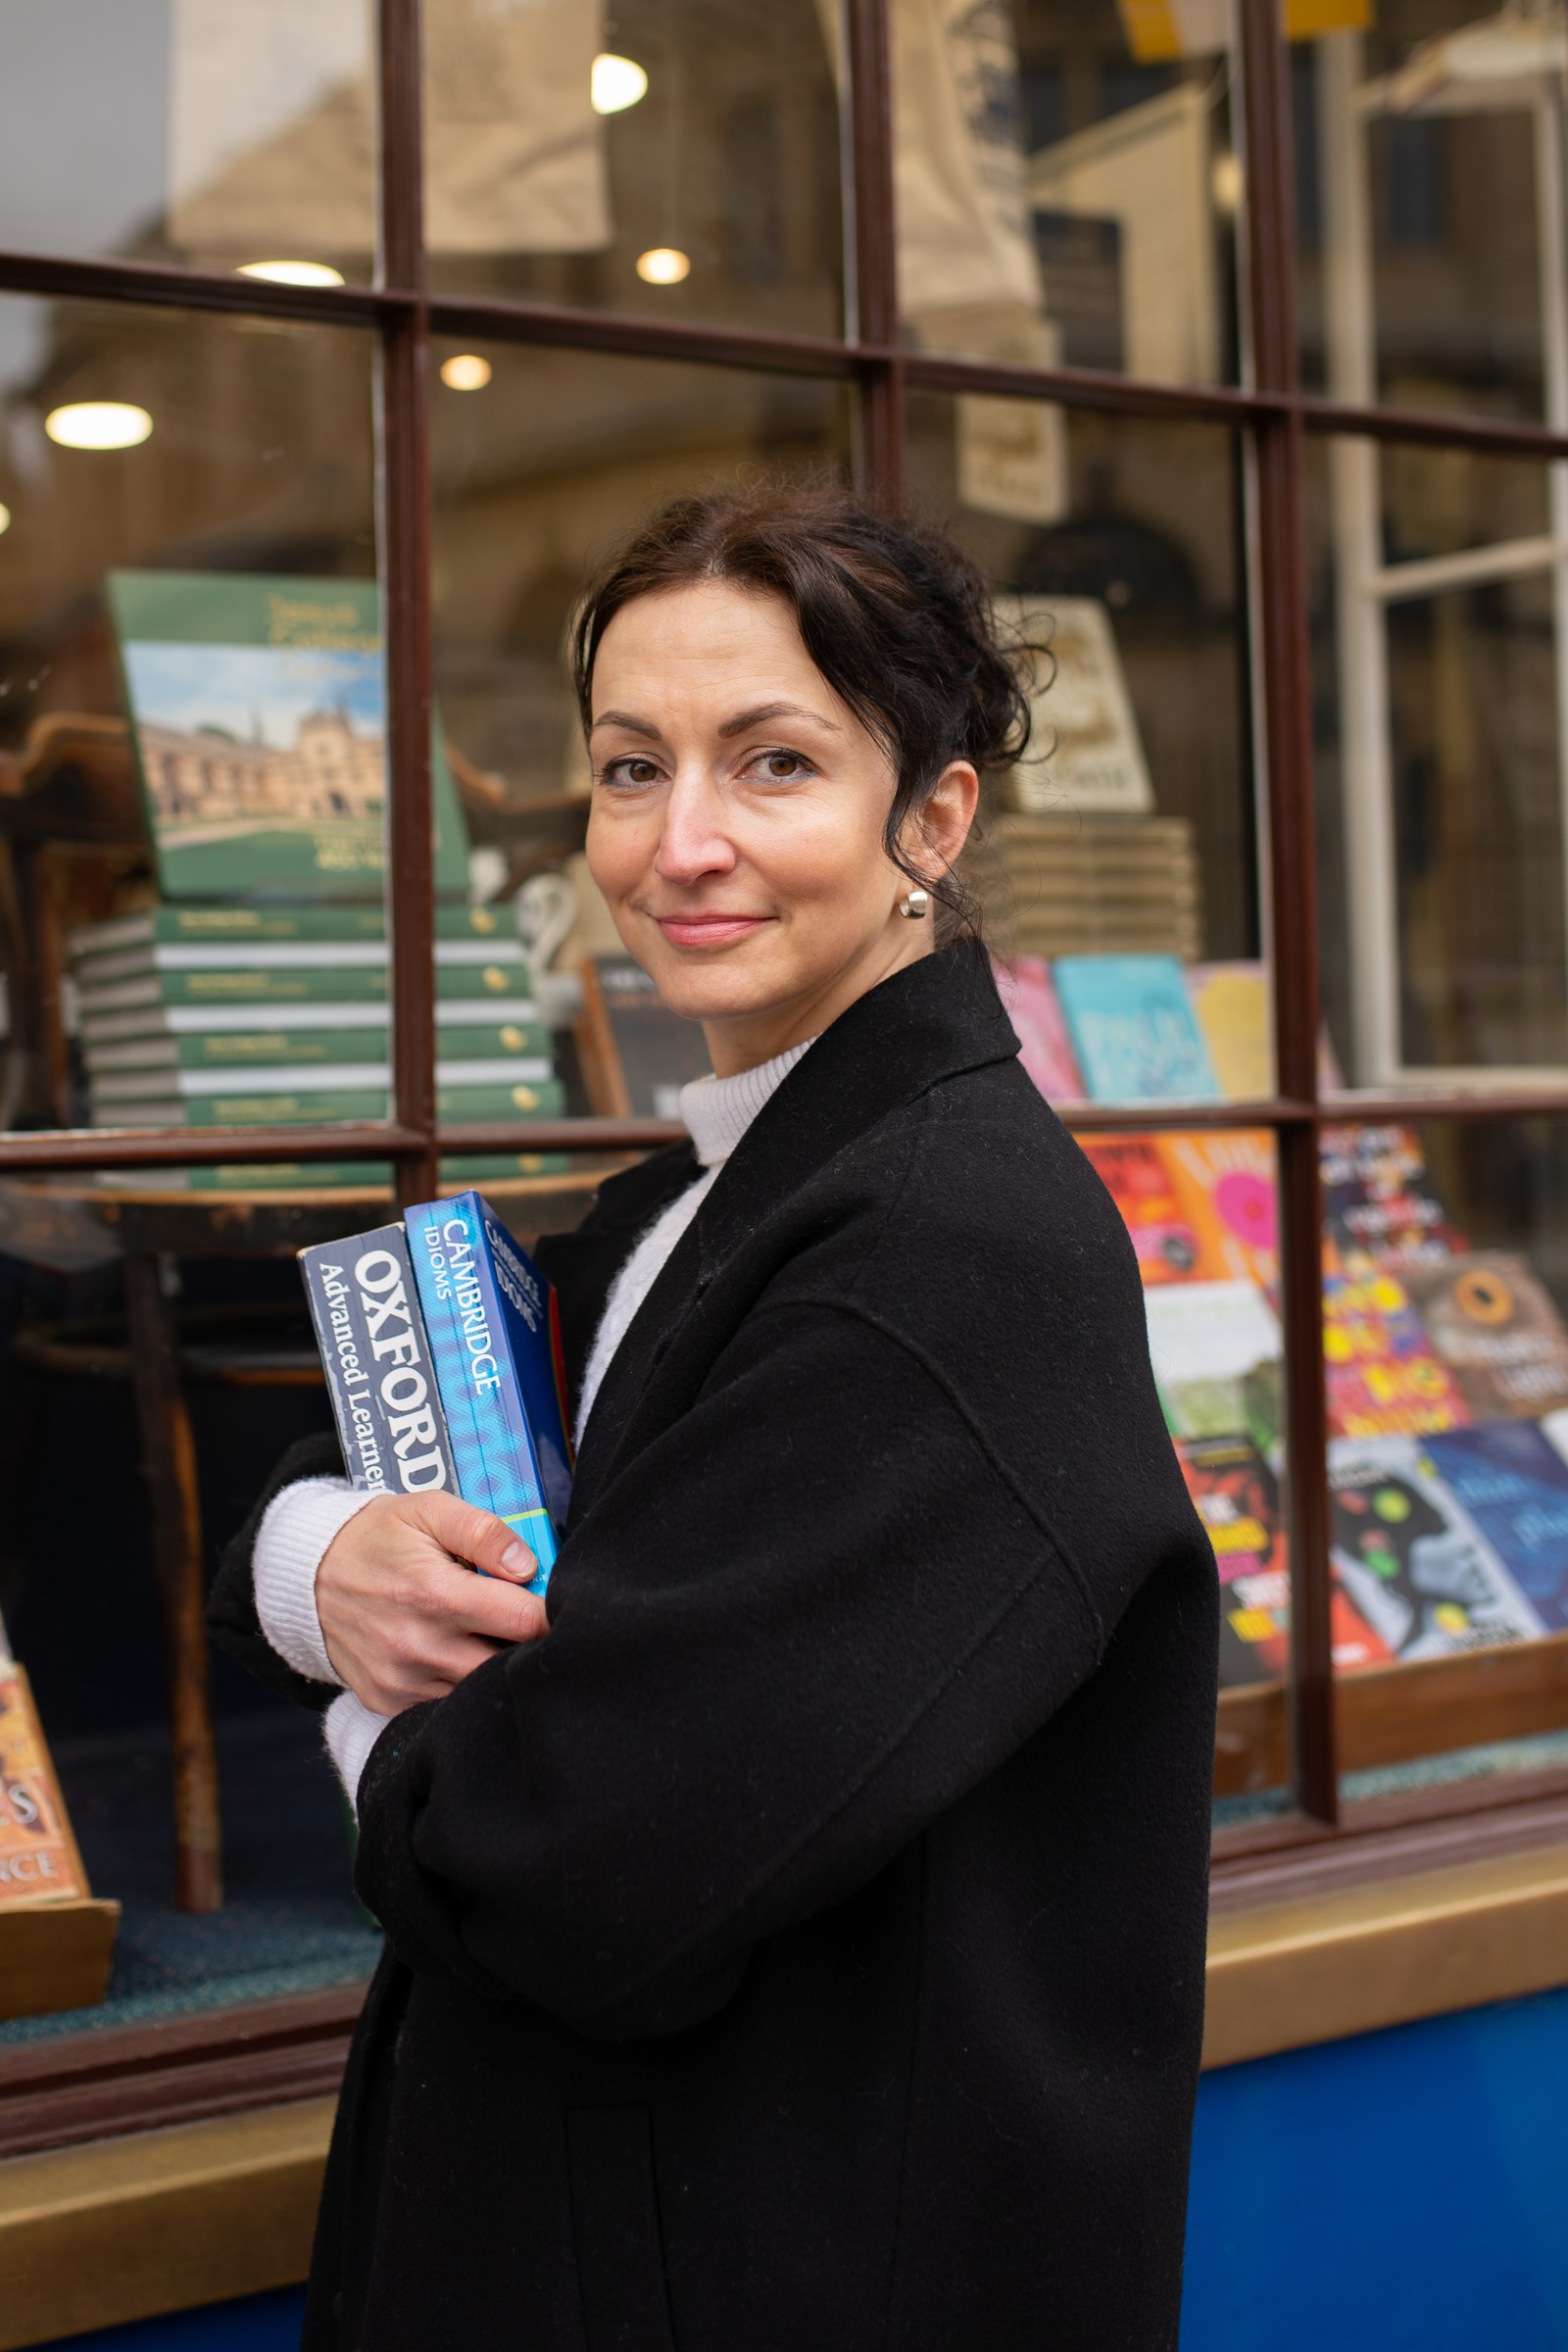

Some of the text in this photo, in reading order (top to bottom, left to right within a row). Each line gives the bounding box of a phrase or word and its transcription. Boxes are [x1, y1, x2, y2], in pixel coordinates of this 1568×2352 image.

[318, 1262, 370, 1387] Advanced
[423, 1226, 452, 1300] IDIOMS
[443, 1219, 501, 1396] CAMBRIDGE
[355, 1250, 447, 1494] OXFORD
